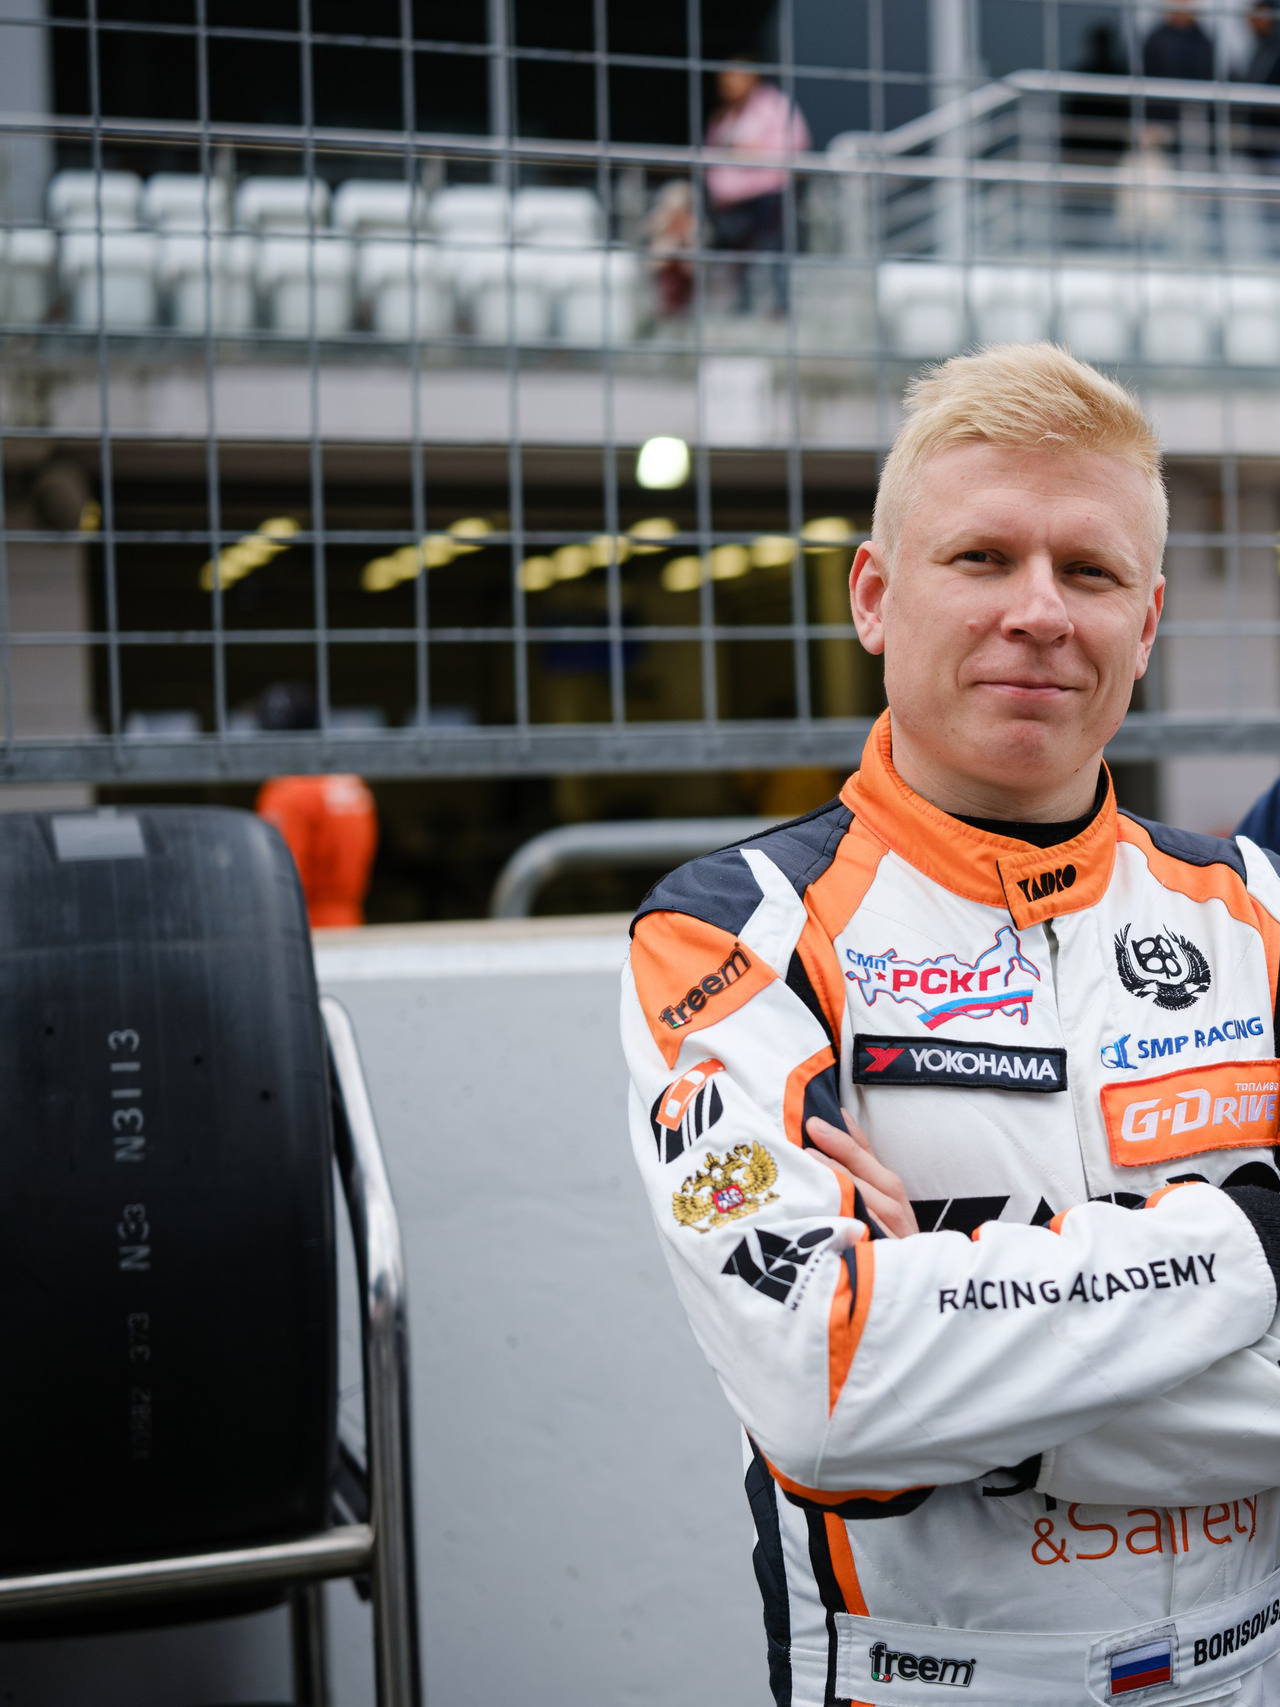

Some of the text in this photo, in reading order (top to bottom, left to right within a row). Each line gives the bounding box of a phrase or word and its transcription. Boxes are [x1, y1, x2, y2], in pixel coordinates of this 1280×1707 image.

[846, 949, 886, 971] СМП
[892, 965, 1001, 995] РСКГ
[660, 948, 751, 1029] freem
[1137, 1016, 1264, 1059] SMP RACING
[908, 1048, 1058, 1081] YOKOHAMA
[938, 1253, 1217, 1314] RACING ACADEMY
[1194, 1605, 1270, 1667] BORISOV
[869, 1642, 974, 1687] freem
